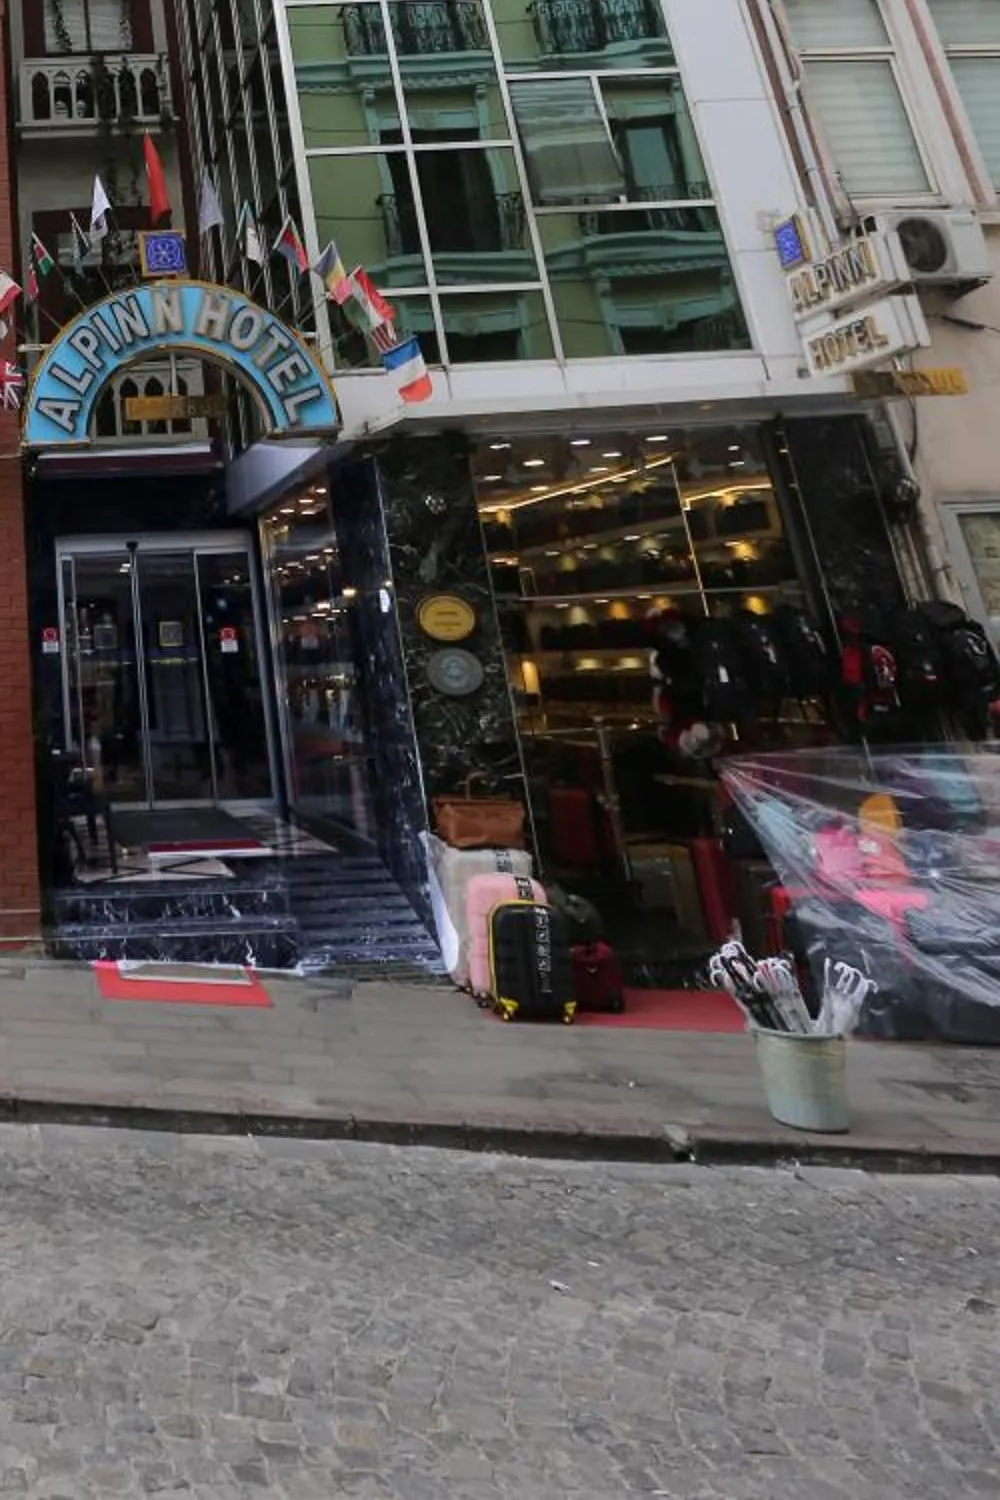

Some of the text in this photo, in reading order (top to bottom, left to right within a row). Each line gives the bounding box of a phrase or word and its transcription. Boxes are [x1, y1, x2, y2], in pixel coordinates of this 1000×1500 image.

[789, 241, 877, 312] ALPINN
[36, 287, 323, 434] ALPINN HOTEL
[808, 315, 889, 370] HOTEL
